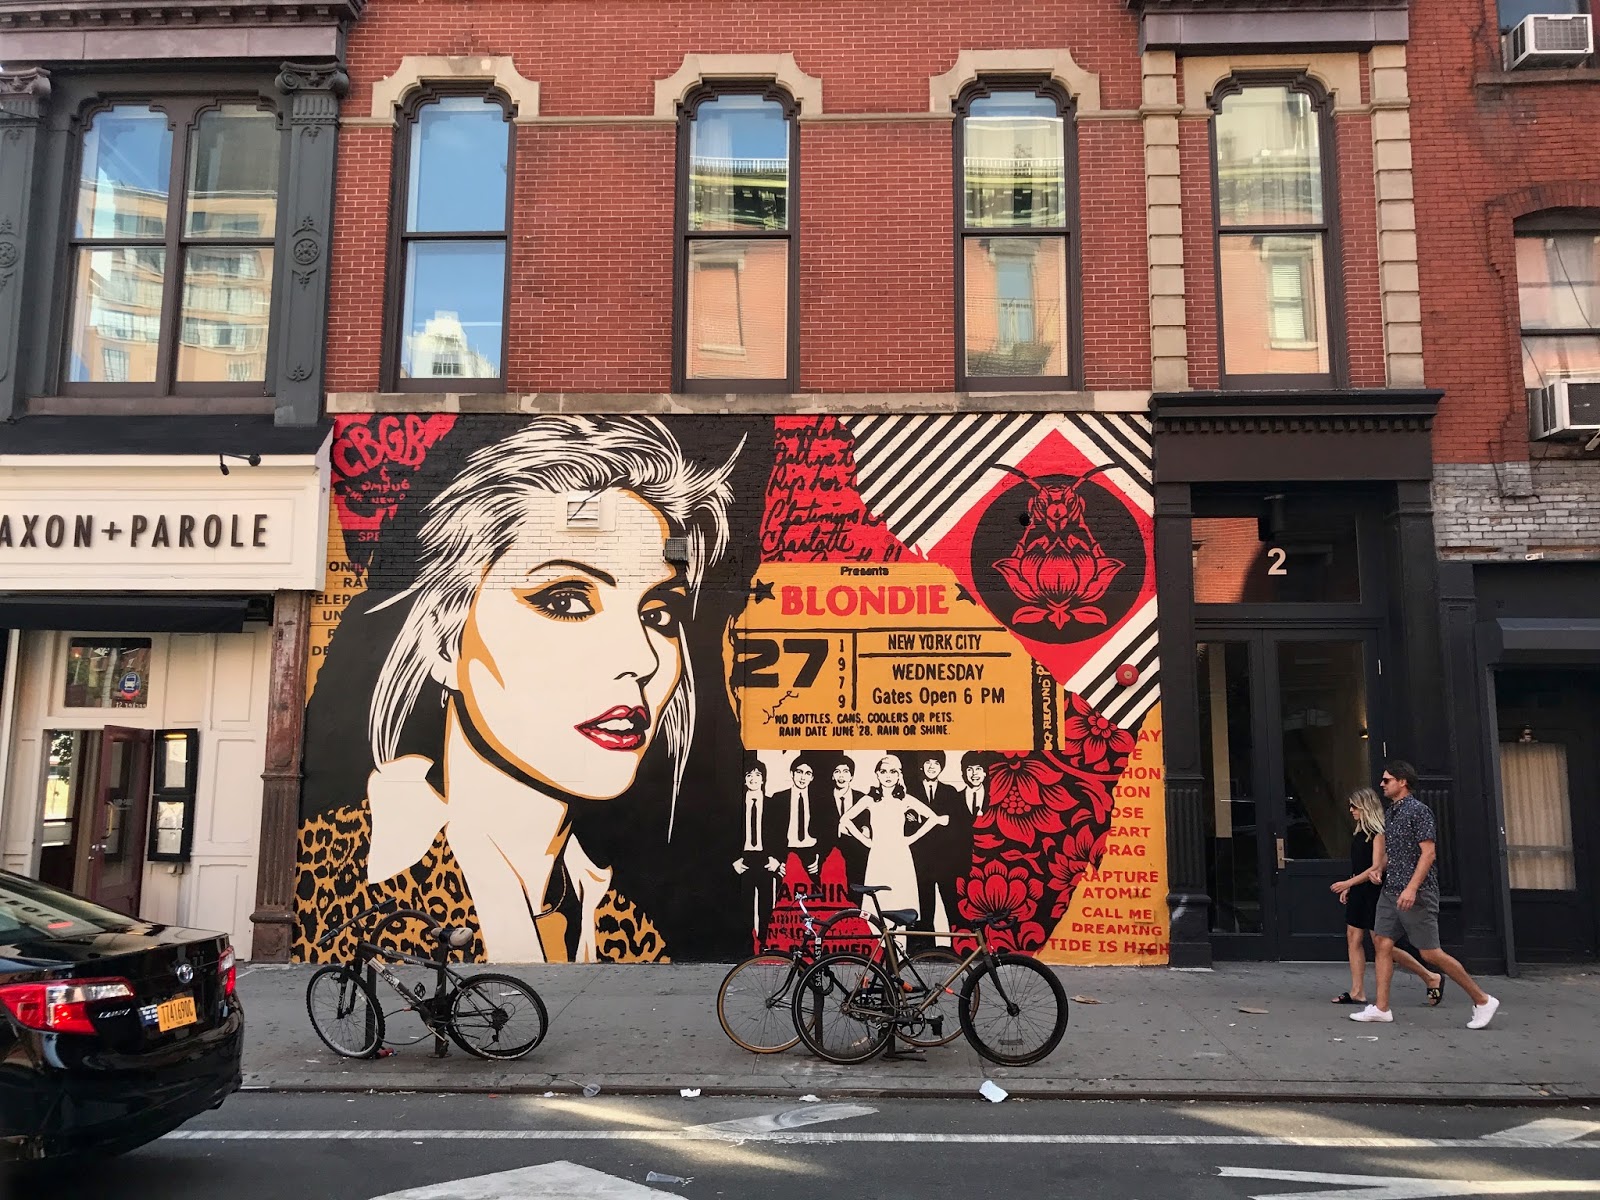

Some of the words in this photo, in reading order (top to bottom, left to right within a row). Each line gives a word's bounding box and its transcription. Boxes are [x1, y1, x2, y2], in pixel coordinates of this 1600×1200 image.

[333, 414, 426, 477] CBGB
[1267, 548, 1288, 575] 2
[840, 566, 889, 576] Presents
[781, 585, 949, 616] BLONDIE
[888, 634, 915, 650] NEW
[919, 634, 953, 650] YORK
[955, 634, 982, 650] CITY
[738, 638, 829, 688] 27
[892, 663, 984, 681] WEDNESDAY
[872, 687, 913, 704] Gates
[919, 687, 957, 706] Open
[964, 687, 973, 704] 6
[981, 687, 1005, 703] PM
[775, 714, 788, 724] NO
[867, 712, 908, 723] COOLERS
[912, 713, 925, 722] OR
[779, 726, 800, 737] RAIN
[805, 726, 827, 736] DATE
[832, 726, 854, 736] JUNE
[877, 725, 899, 736] RAIN
[903, 725, 916, 735] OR
[1138, 730, 1161, 742] AY
[1122, 767, 1161, 779] HON
[1115, 785, 1150, 798] ION
[1111, 807, 1144, 818] OSE
[1108, 826, 1151, 837] EART
[1080, 870, 1158, 883] RAPTURE
[1083, 887, 1151, 899] ATOMIC
[1082, 906, 1123, 919] CALL
[1129, 909, 1152, 919] ME
[1072, 922, 1162, 936] DREAMING
[1048, 938, 1091, 952] TIDE
[1098, 940, 1118, 953] IS
[1124, 941, 1169, 955] HIGH
